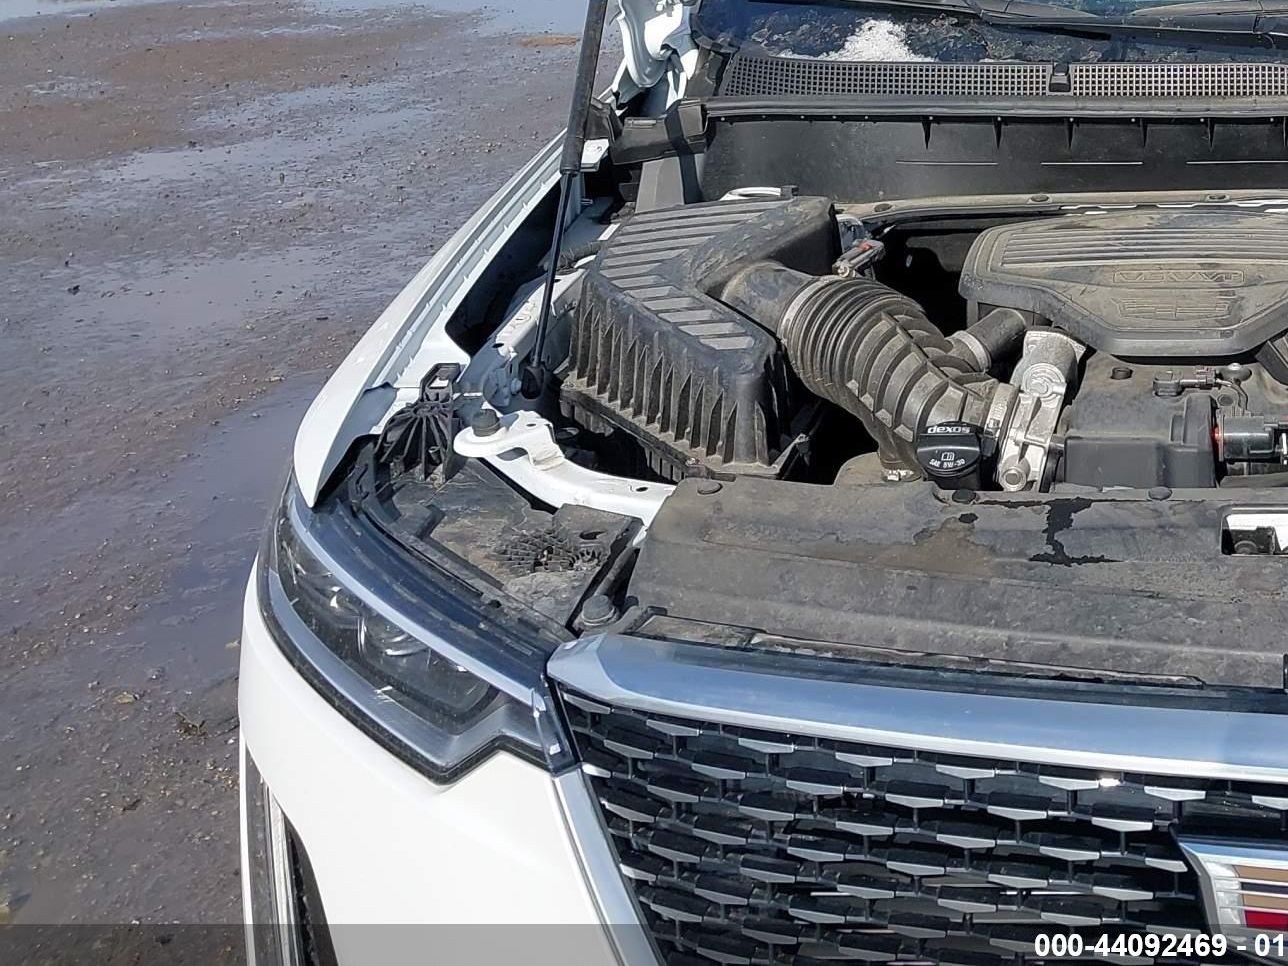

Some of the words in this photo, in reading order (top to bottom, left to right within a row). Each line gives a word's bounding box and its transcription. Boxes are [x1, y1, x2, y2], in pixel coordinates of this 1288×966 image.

[927, 425, 971, 434] dexos
[929, 458, 942, 468] SAE
[943, 458, 966, 469] 5W-30
